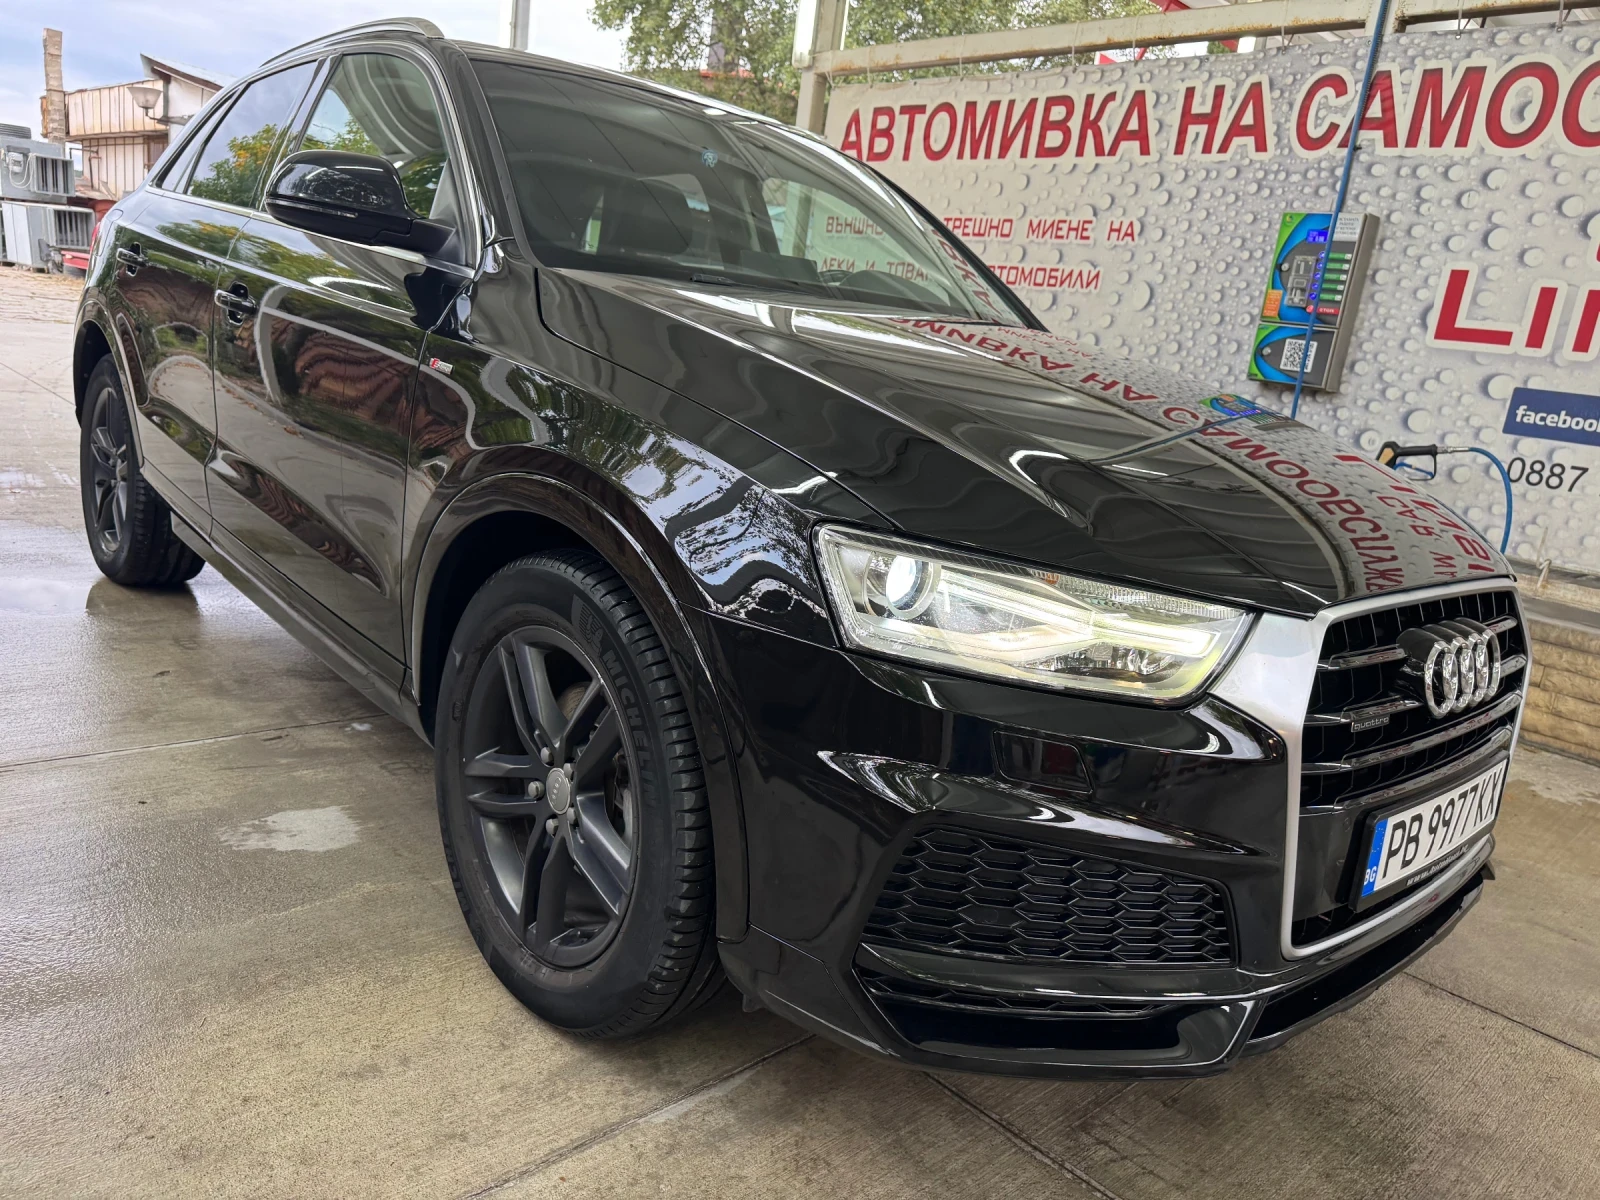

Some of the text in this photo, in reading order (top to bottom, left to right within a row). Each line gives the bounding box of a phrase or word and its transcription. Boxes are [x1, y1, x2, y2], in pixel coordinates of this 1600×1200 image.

[841, 89, 1150, 162] АВТОМИВКА
[1174, 83, 1268, 154] НА
[1026, 219, 1093, 241] МИЕНЕ
[1107, 220, 1135, 242] НА
[1507, 456, 1590, 493] 0887
[1354, 716, 1389, 730] quattro
[1381, 812, 1423, 879] PB
[1425, 783, 1480, 859] 9977
[1364, 866, 1377, 885] BG
